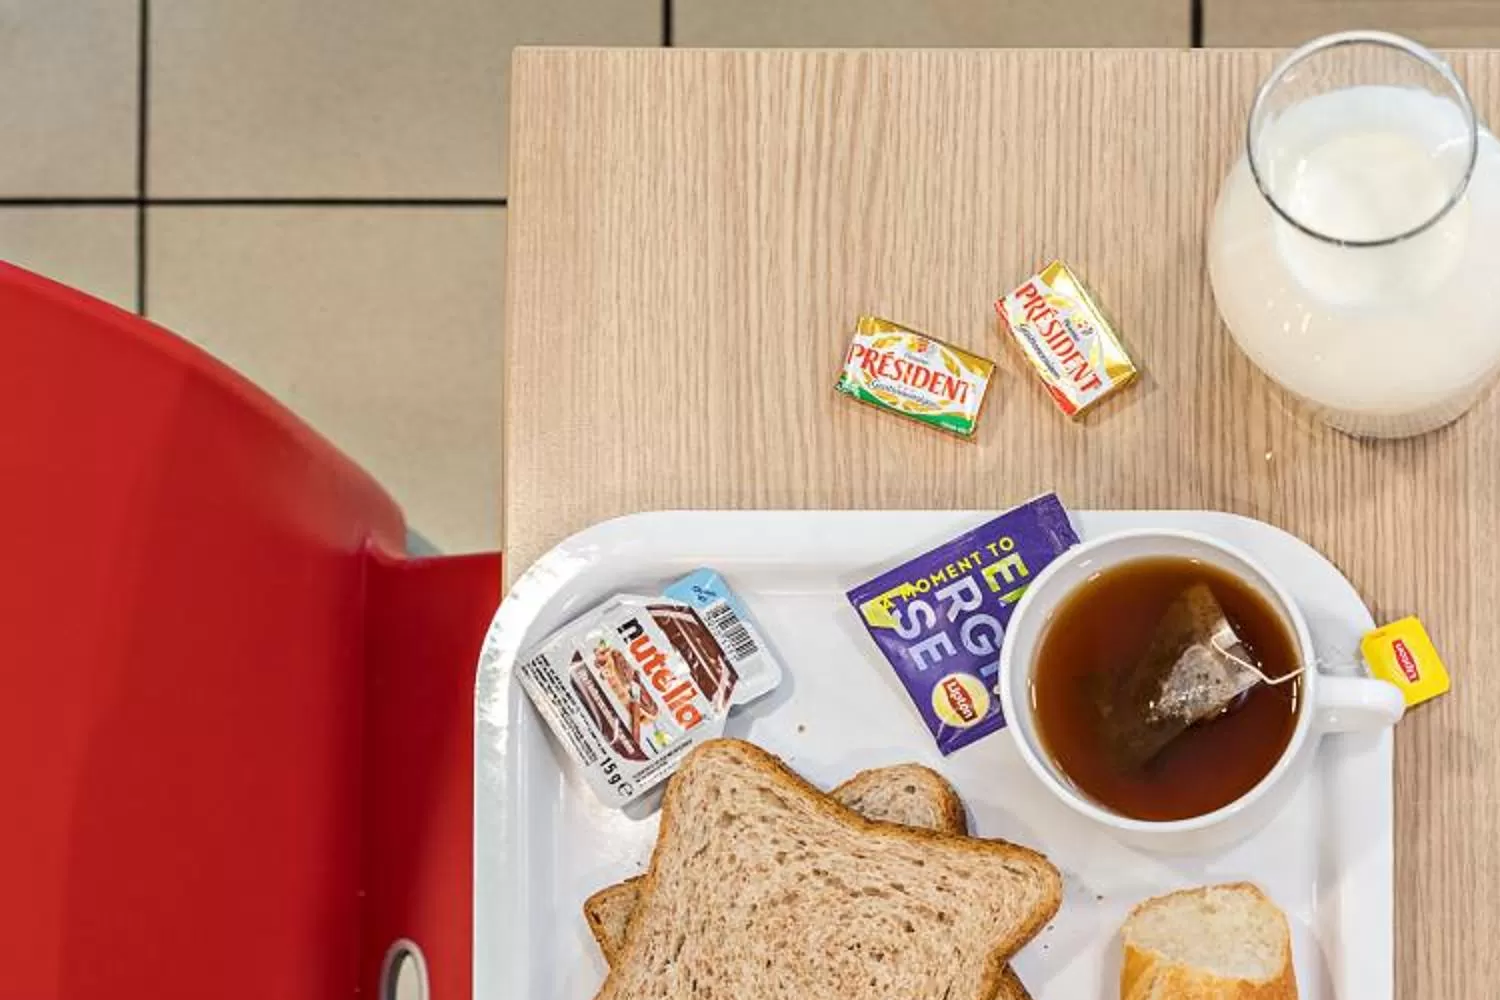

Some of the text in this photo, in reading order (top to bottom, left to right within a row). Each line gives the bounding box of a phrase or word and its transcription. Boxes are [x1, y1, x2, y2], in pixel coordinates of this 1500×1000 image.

[847, 343, 969, 404] PRÉSIDENT
[1014, 281, 1102, 393] PRÉSIDENT
[902, 552, 982, 599] MOMENT
[987, 536, 1014, 558] TO
[616, 617, 702, 733] nutella
